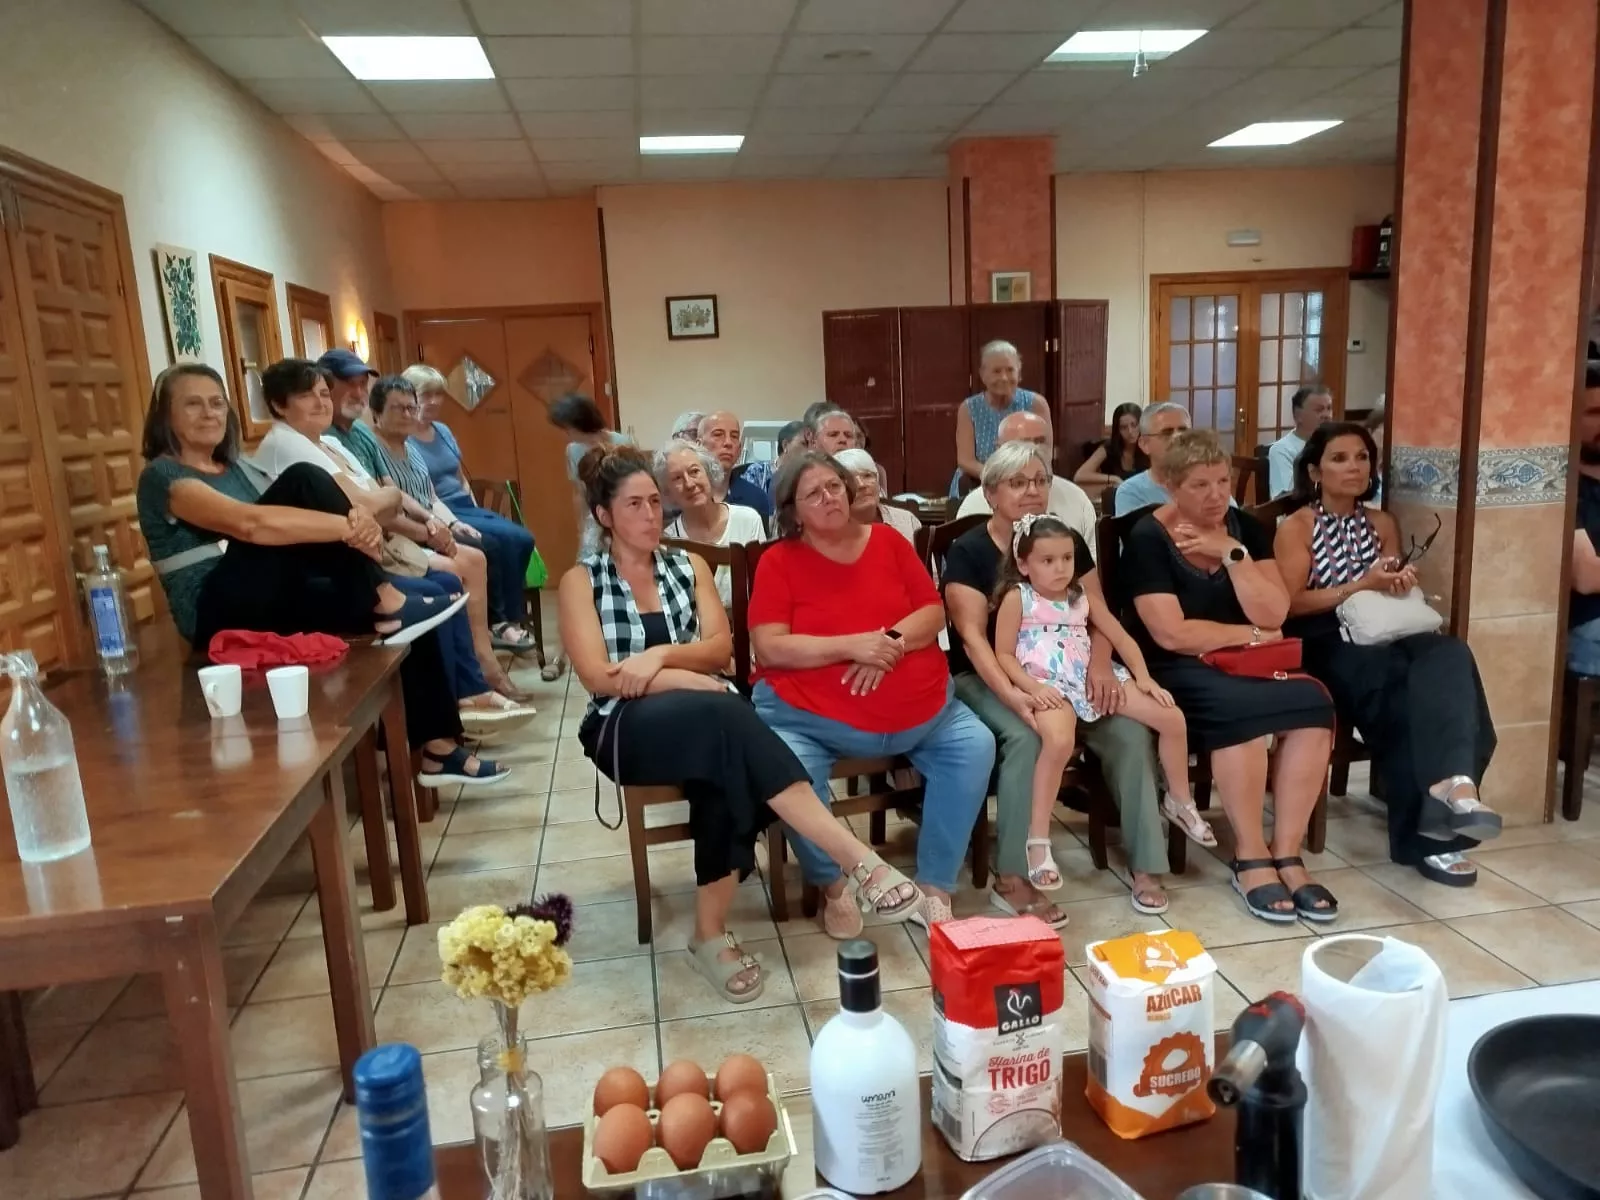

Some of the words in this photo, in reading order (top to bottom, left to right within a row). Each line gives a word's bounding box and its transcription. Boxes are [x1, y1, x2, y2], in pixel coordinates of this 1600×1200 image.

[1001, 1015, 1040, 1031] GALLO
[988, 1052, 1034, 1067] Harina
[1037, 1047, 1050, 1059] de
[988, 1059, 1050, 1091] TRIGO
